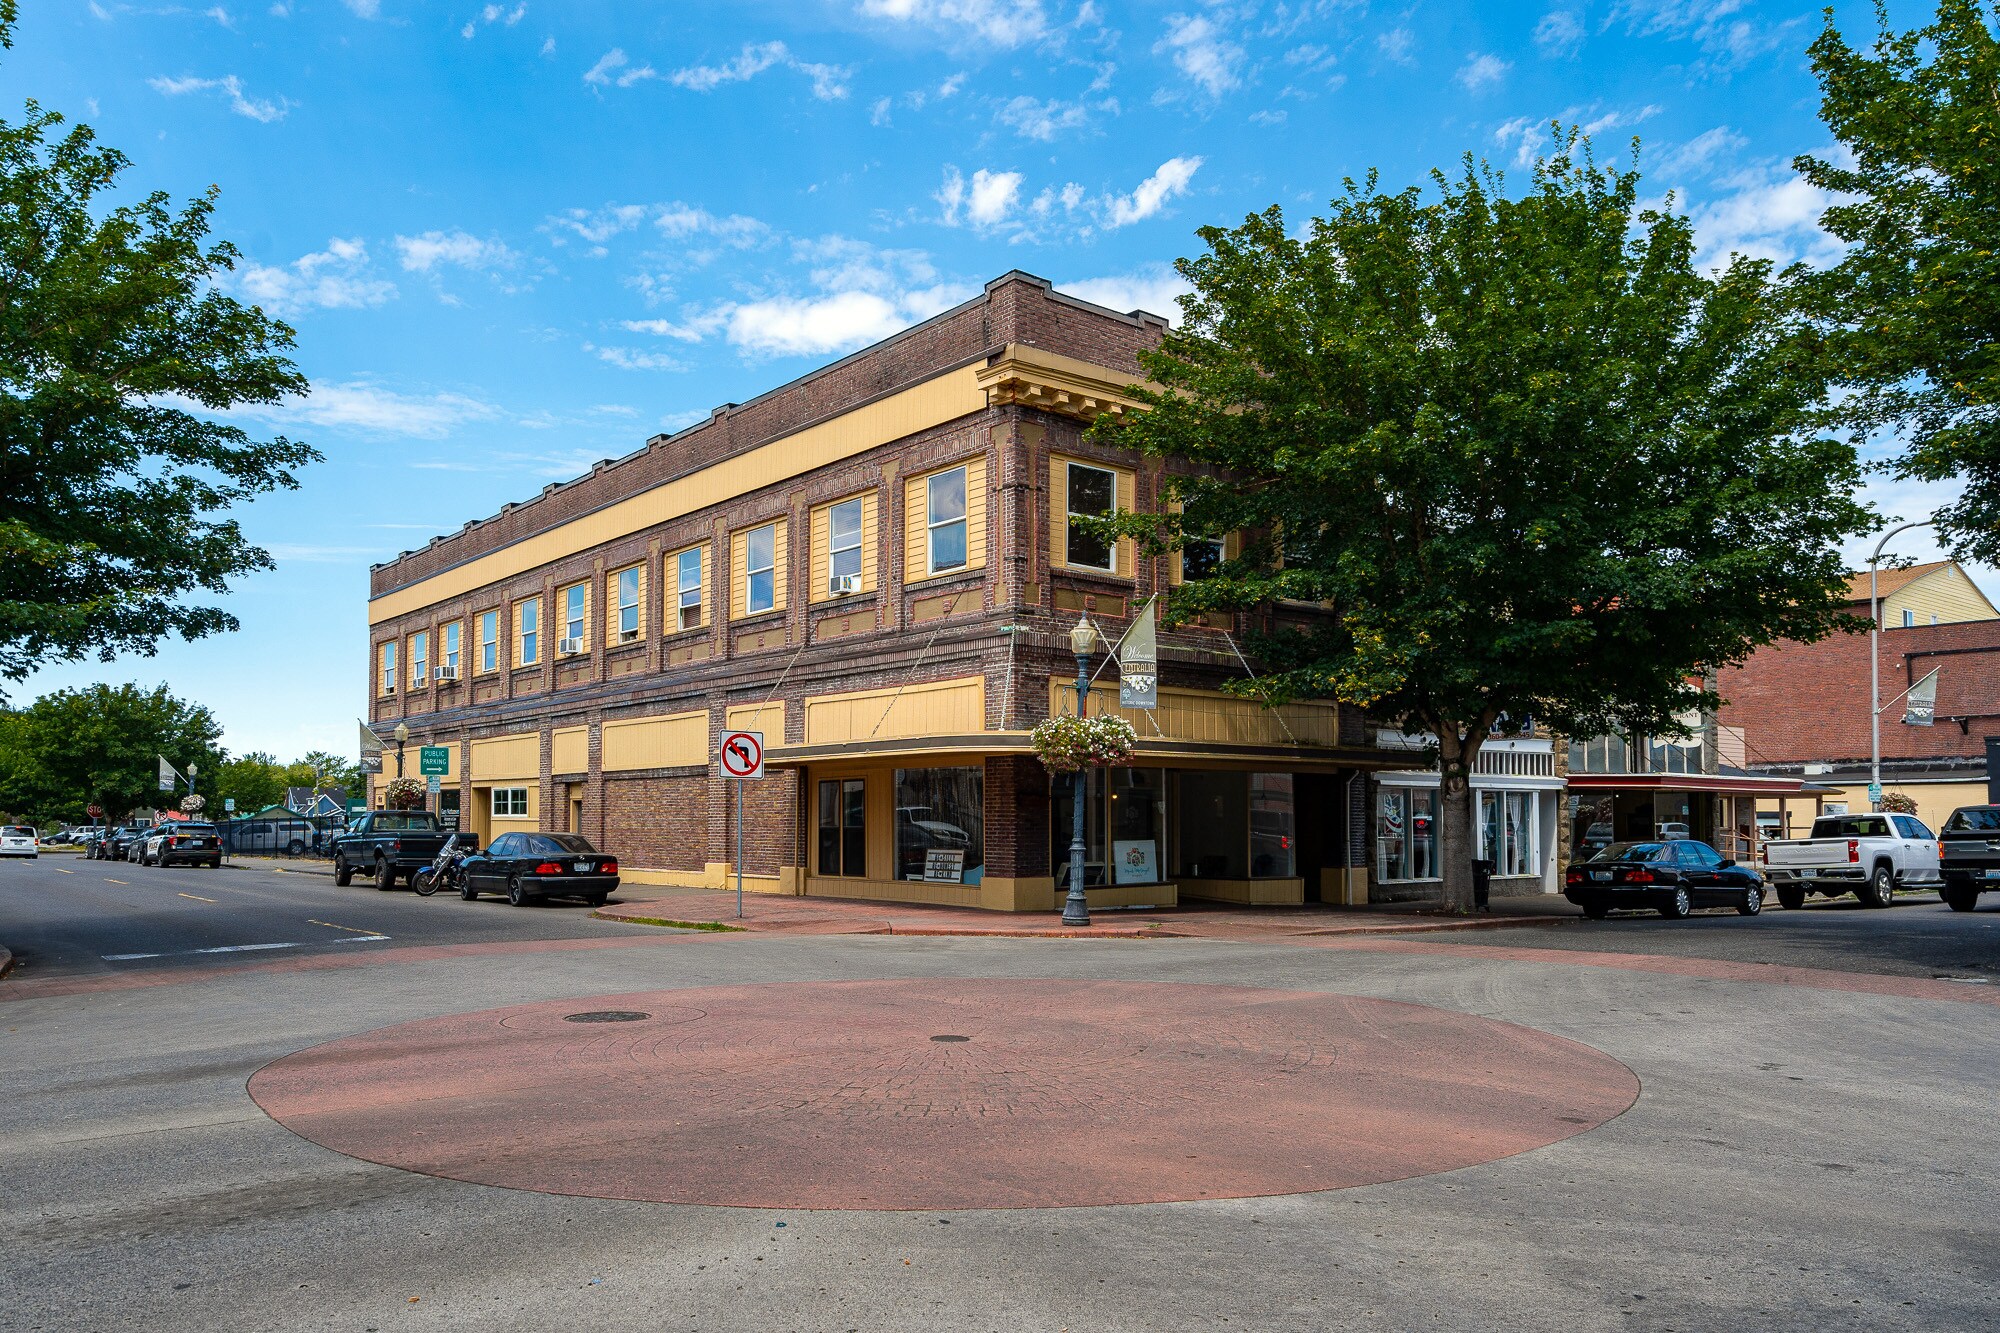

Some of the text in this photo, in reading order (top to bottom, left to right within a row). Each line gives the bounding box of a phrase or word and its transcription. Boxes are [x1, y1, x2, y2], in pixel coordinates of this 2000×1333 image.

[1122, 643, 1154, 659] Welcome
[1121, 663, 1156, 675] CENTRALIA
[88, 805, 102, 814] STO
[148, 841, 159, 849] POLICE
